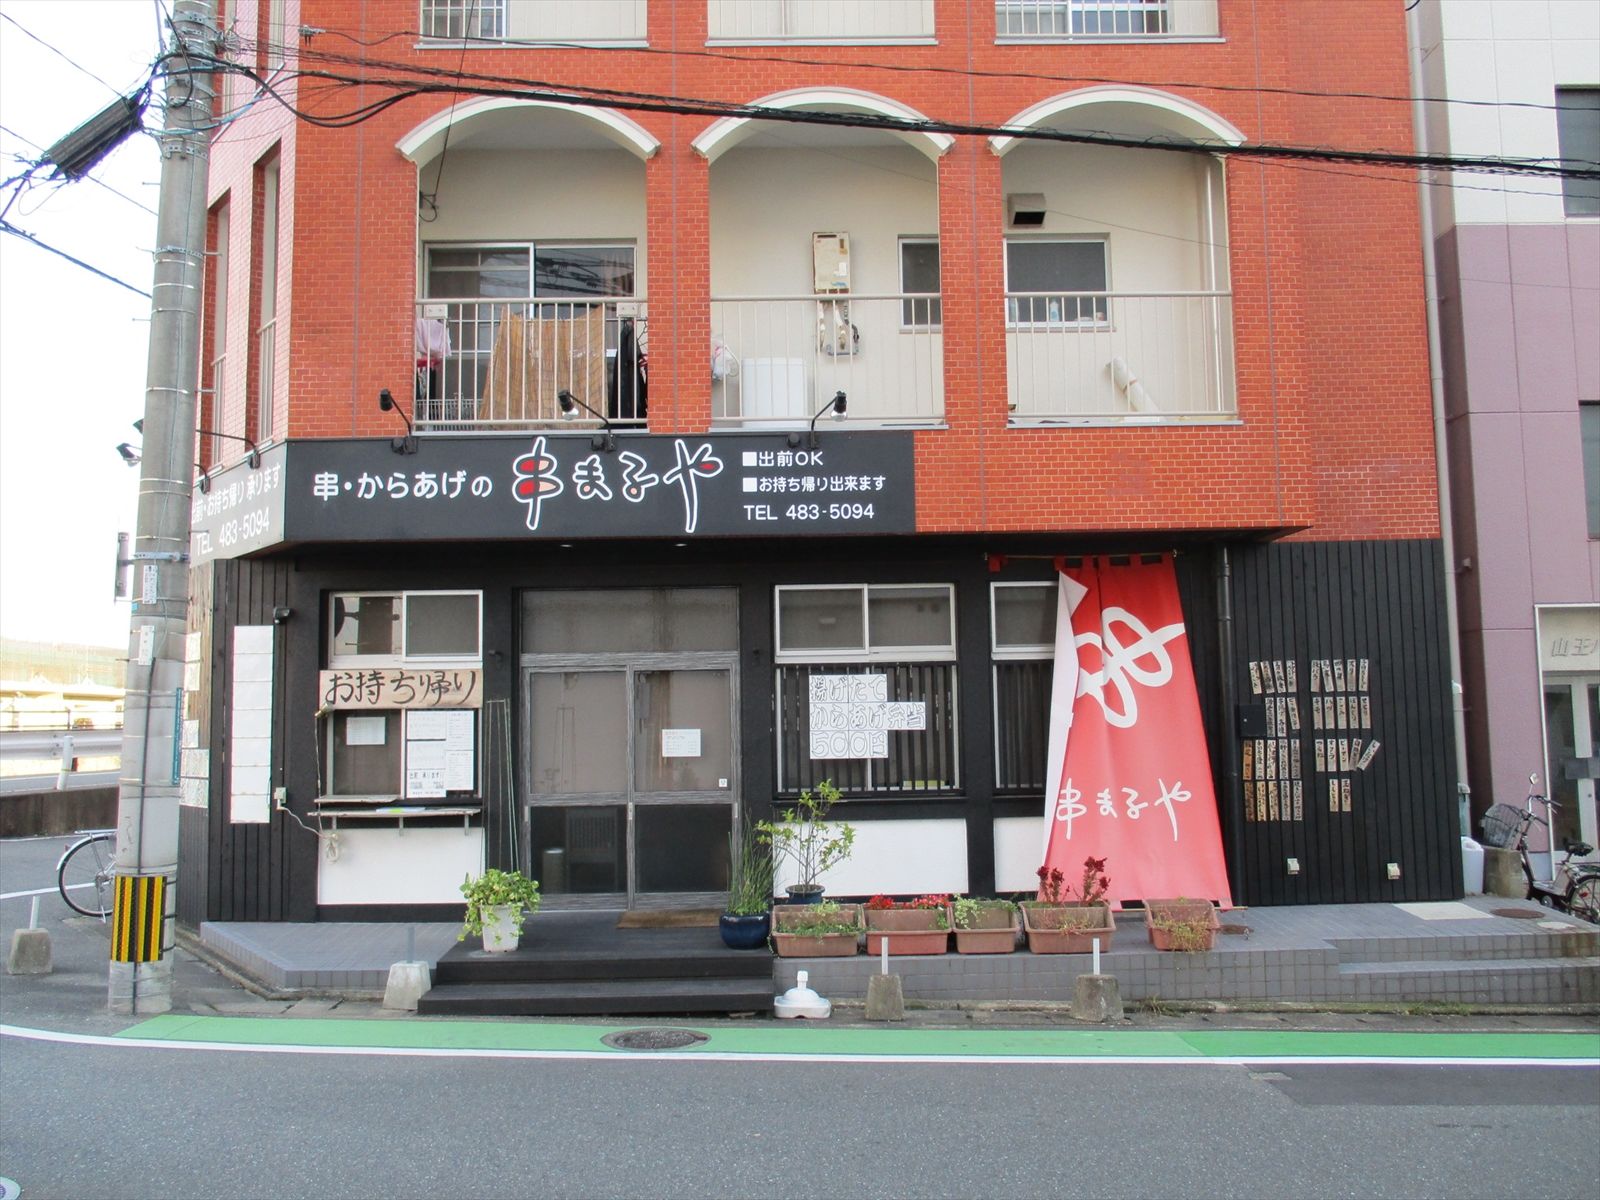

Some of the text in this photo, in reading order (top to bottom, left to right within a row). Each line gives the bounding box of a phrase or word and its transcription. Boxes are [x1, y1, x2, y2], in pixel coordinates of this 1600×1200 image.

[758, 450, 824, 467] 出前OK
[313, 471, 493, 501] 串・からあげの
[758, 476, 887, 492] お持ち帰り出来ます
[743, 503, 875, 521] TEL 483-5094
[196, 506, 271, 556] TEL 483-5094
[1551, 637, 1600, 657] 山王
[325, 669, 476, 706] お持ち帰り
[809, 675, 887, 702] 揚げたて
[810, 703, 925, 730] からあげ弁当
[811, 731, 888, 757] 500円
[1056, 777, 1192, 841] 串まるや
